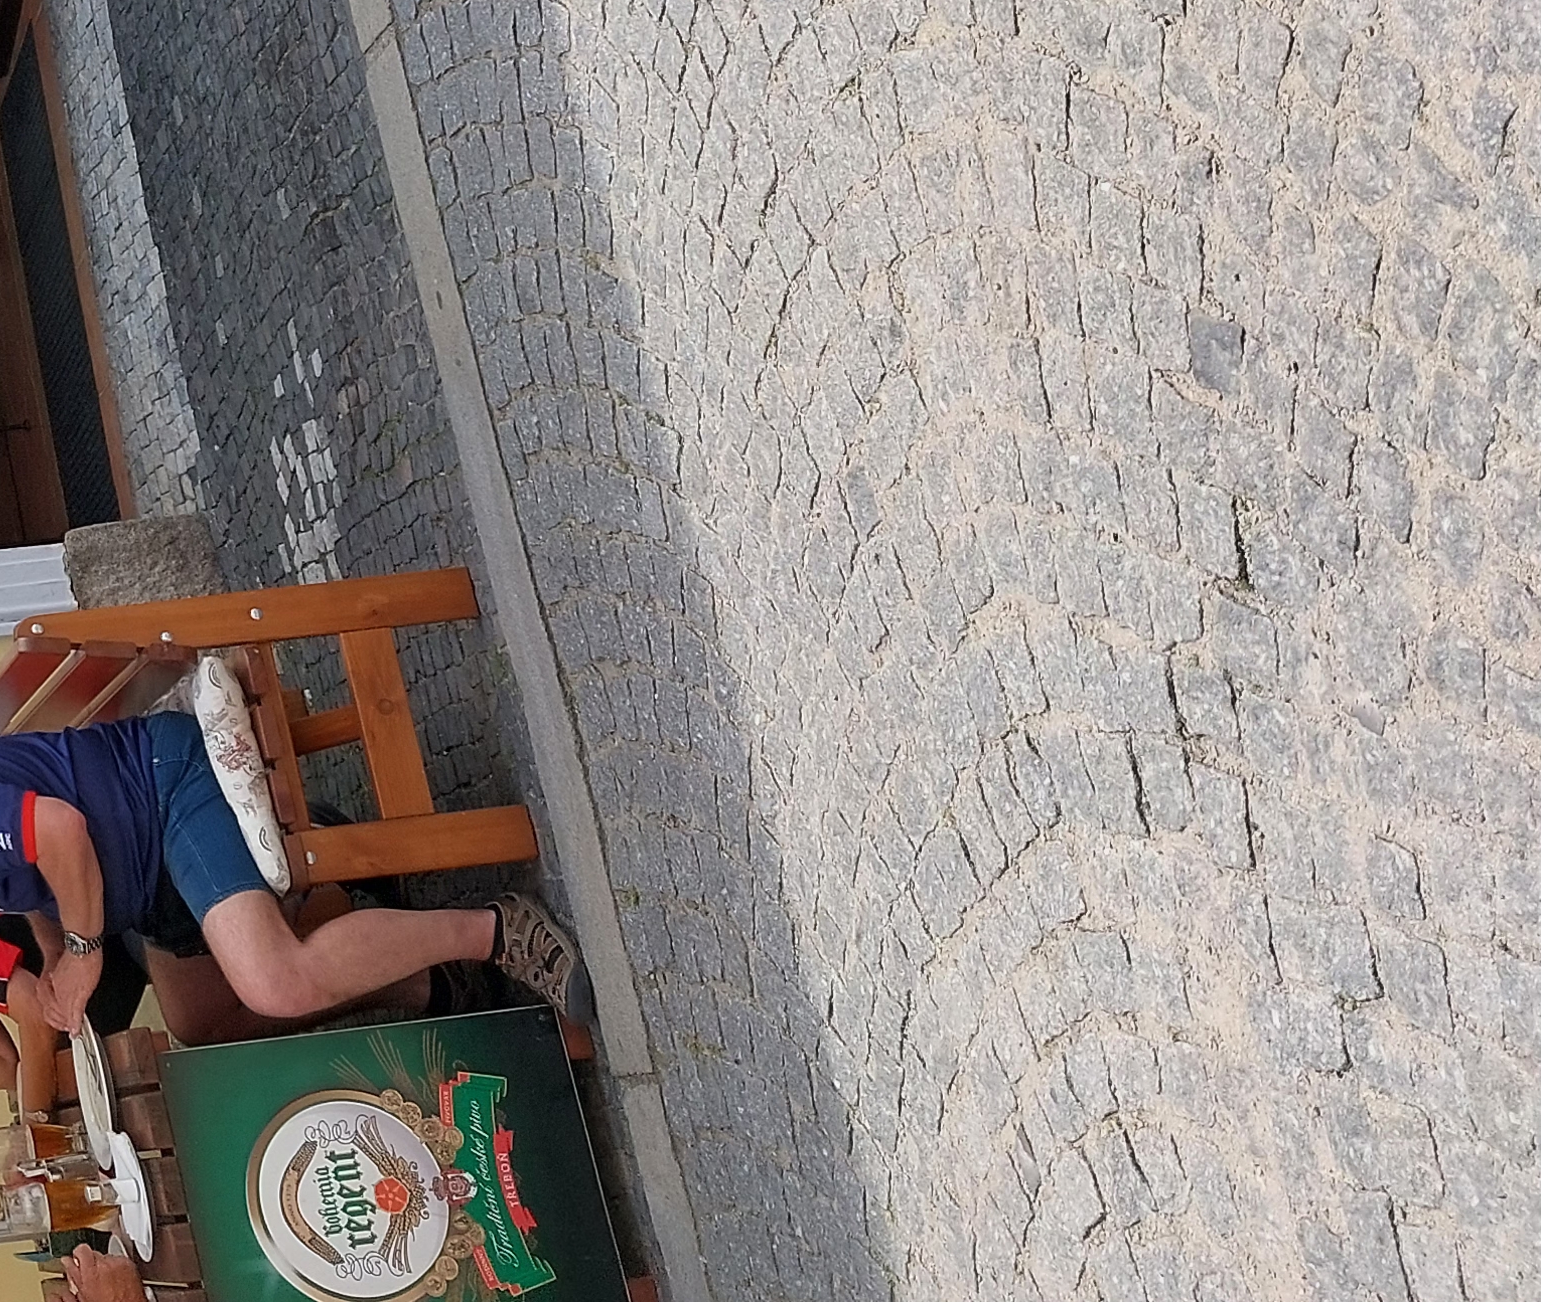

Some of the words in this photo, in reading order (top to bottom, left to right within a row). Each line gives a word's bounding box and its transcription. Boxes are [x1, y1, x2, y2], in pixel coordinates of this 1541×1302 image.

[443, 1089, 451, 1124] PIVOVAR
[468, 1099, 490, 1138] pivo
[469, 1134, 492, 1181] české
[495, 1152, 520, 1208] TŘEBOŇ
[324, 1147, 378, 1250] regent
[477, 1182, 519, 1268] Tradiční
